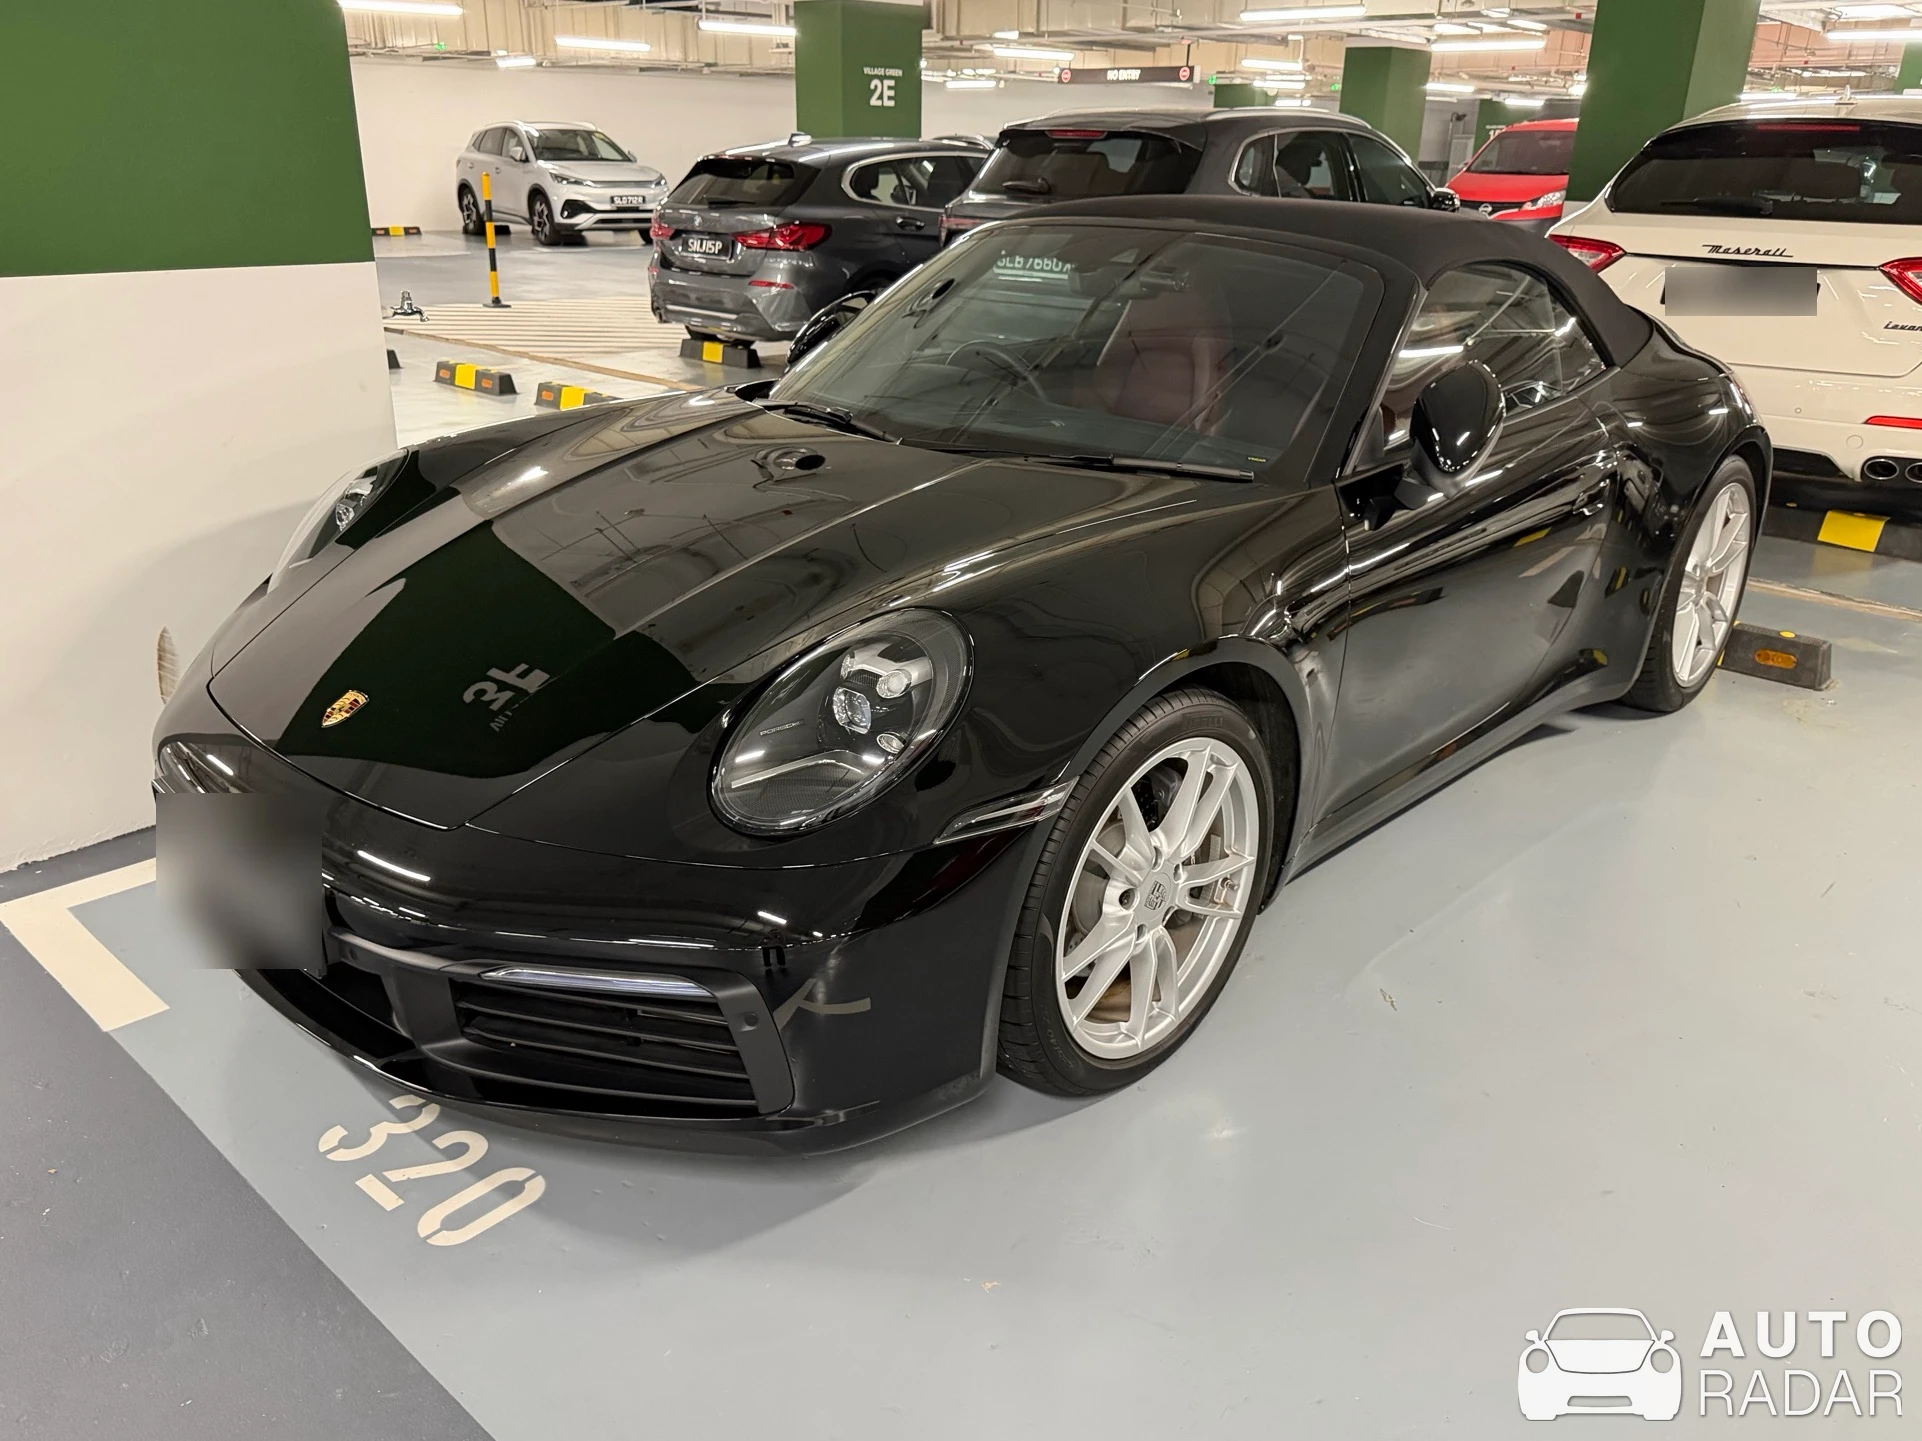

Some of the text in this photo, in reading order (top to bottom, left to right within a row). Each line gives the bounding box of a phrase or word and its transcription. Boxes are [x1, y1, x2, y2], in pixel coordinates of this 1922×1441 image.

[863, 66, 903, 77] VILLAGE GREEN
[1107, 69, 1141, 81] NO ENTRY
[870, 78, 895, 107] 2E
[1702, 244, 1794, 258] Maserati
[318, 1093, 546, 1247] 320
